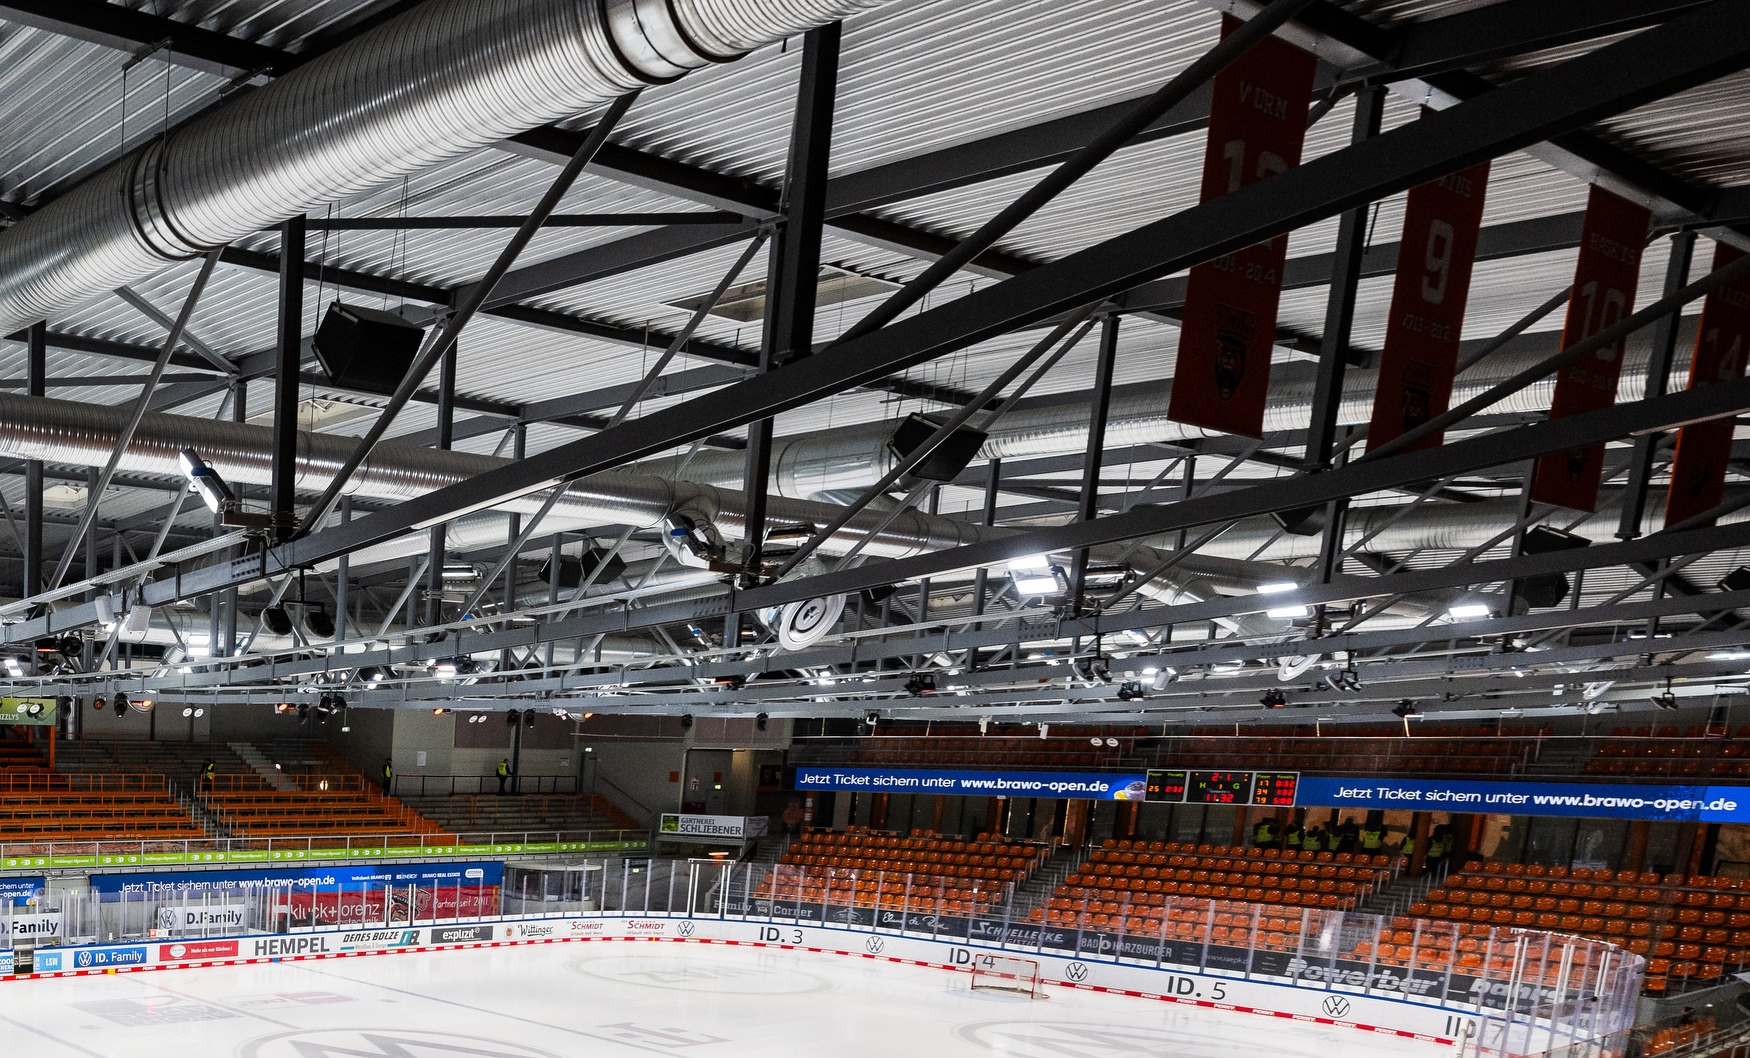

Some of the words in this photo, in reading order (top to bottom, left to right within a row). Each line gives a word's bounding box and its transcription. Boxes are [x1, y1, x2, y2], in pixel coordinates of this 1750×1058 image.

[1420, 217, 1453, 305] 9
[800, 773, 830, 789] Jetzt
[833, 773, 870, 786] Ticket
[872, 774, 927, 788] sichern
[929, 777, 956, 789] unter
[960, 778, 1109, 793] www.brawo-open.de
[1199, 781, 1207, 790] H
[1232, 782, 1240, 790] G
[1334, 787, 1373, 801] Jetzt
[1377, 787, 1422, 802] Ticket
[1425, 789, 1482, 803] sichern
[1485, 791, 1530, 805] unter
[1533, 792, 1738, 813] www.brawo-open.de
[680, 824, 742, 836] SCHLIEBENER
[119, 882, 144, 893] Jetzt
[177, 880, 211, 891] sichern
[212, 879, 237, 890] unter
[238, 875, 335, 888] www.brawo-open.de
[713, 899, 752, 913] Family
[773, 905, 813, 918] Corner
[12, 919, 59, 936] Family
[517, 924, 554, 937] Wittinger
[571, 920, 604, 931] SCHMIDT
[627, 919, 666, 930] SCHMIDT
[970, 921, 1065, 943] SCHNELLECKE
[343, 933, 371, 943] DENES
[372, 930, 400, 941] BOLZE
[760, 926, 786, 943] ID.
[791, 929, 803, 944] 3
[254, 936, 330, 956] HEMPEL
[1080, 936, 1099, 949] BAD
[1112, 941, 1173, 958] HARZBURGER
[46, 957, 59, 966] LSW
[95, 953, 109, 964] ID.
[111, 950, 143, 963] Family
[949, 948, 976, 967] ID.
[982, 953, 996, 969] 4
[1284, 957, 1439, 994] Powerbar
[1166, 975, 1202, 998] ID.
[1211, 981, 1227, 1000] 5
